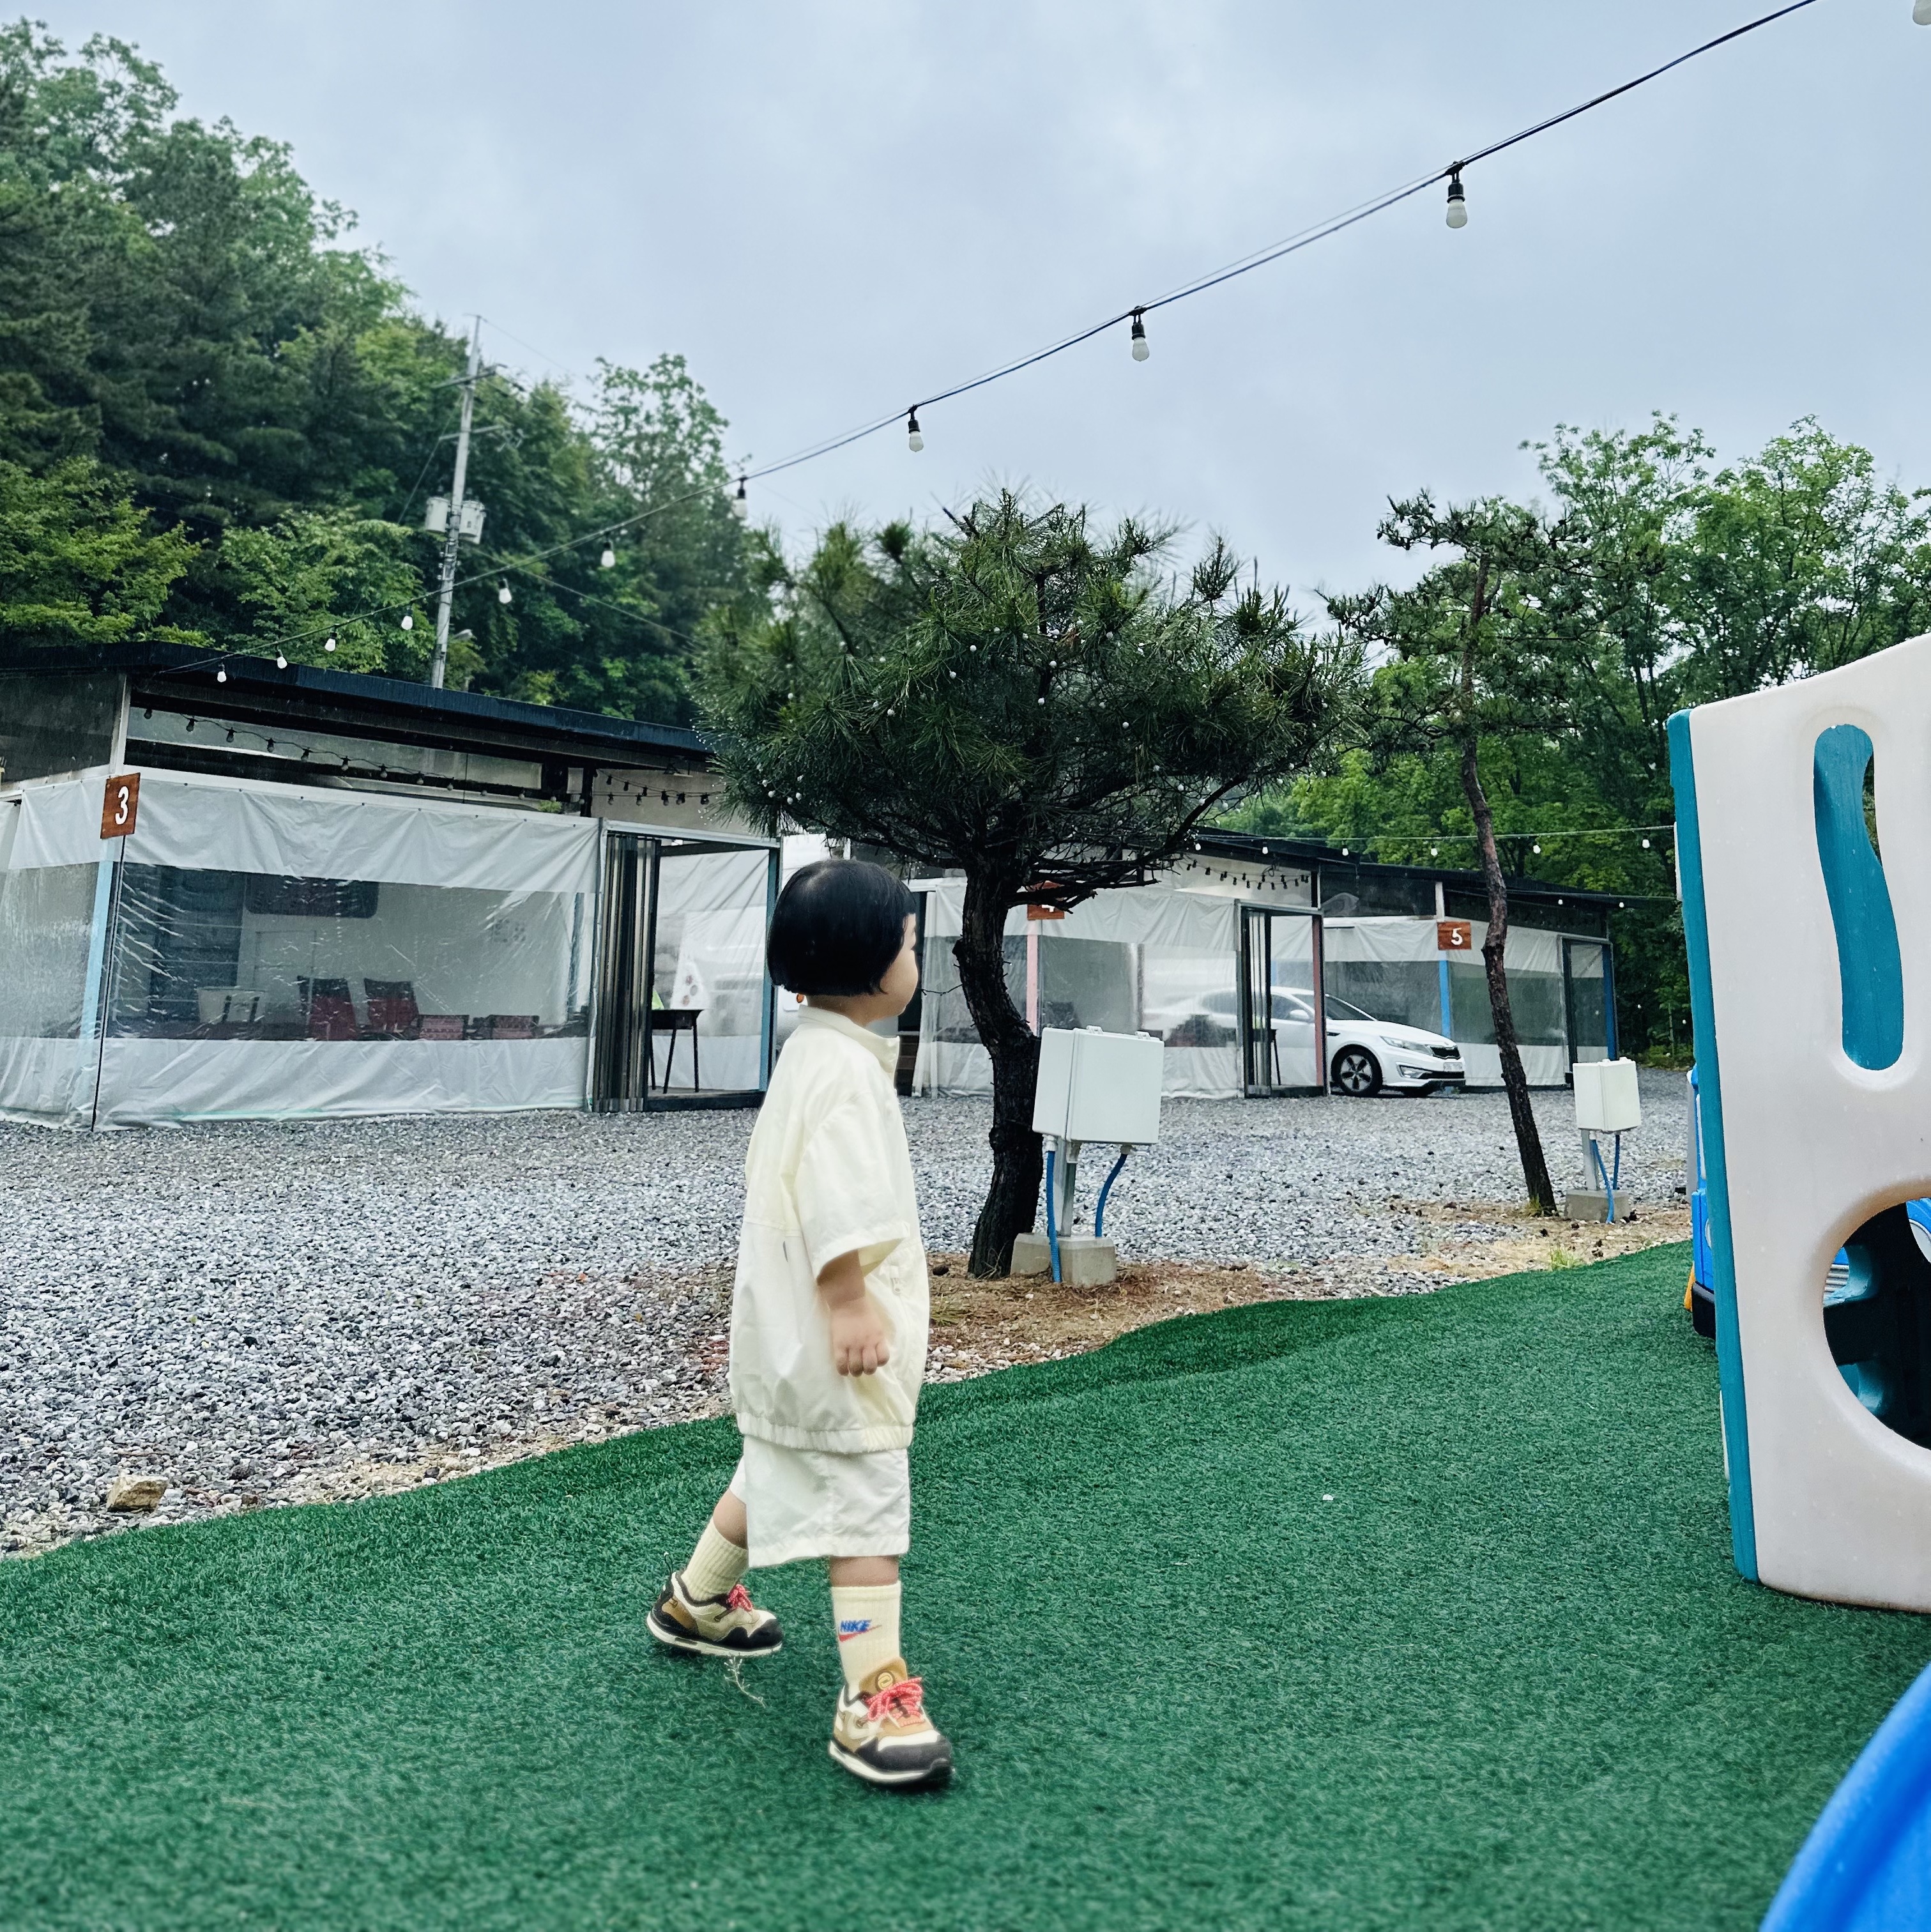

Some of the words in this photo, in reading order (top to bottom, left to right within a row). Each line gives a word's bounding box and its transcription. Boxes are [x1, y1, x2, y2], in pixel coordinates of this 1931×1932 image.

[115, 786, 129, 825] 3
[1451, 927, 1463, 946] 5
[840, 1619, 872, 1632] NIKE
